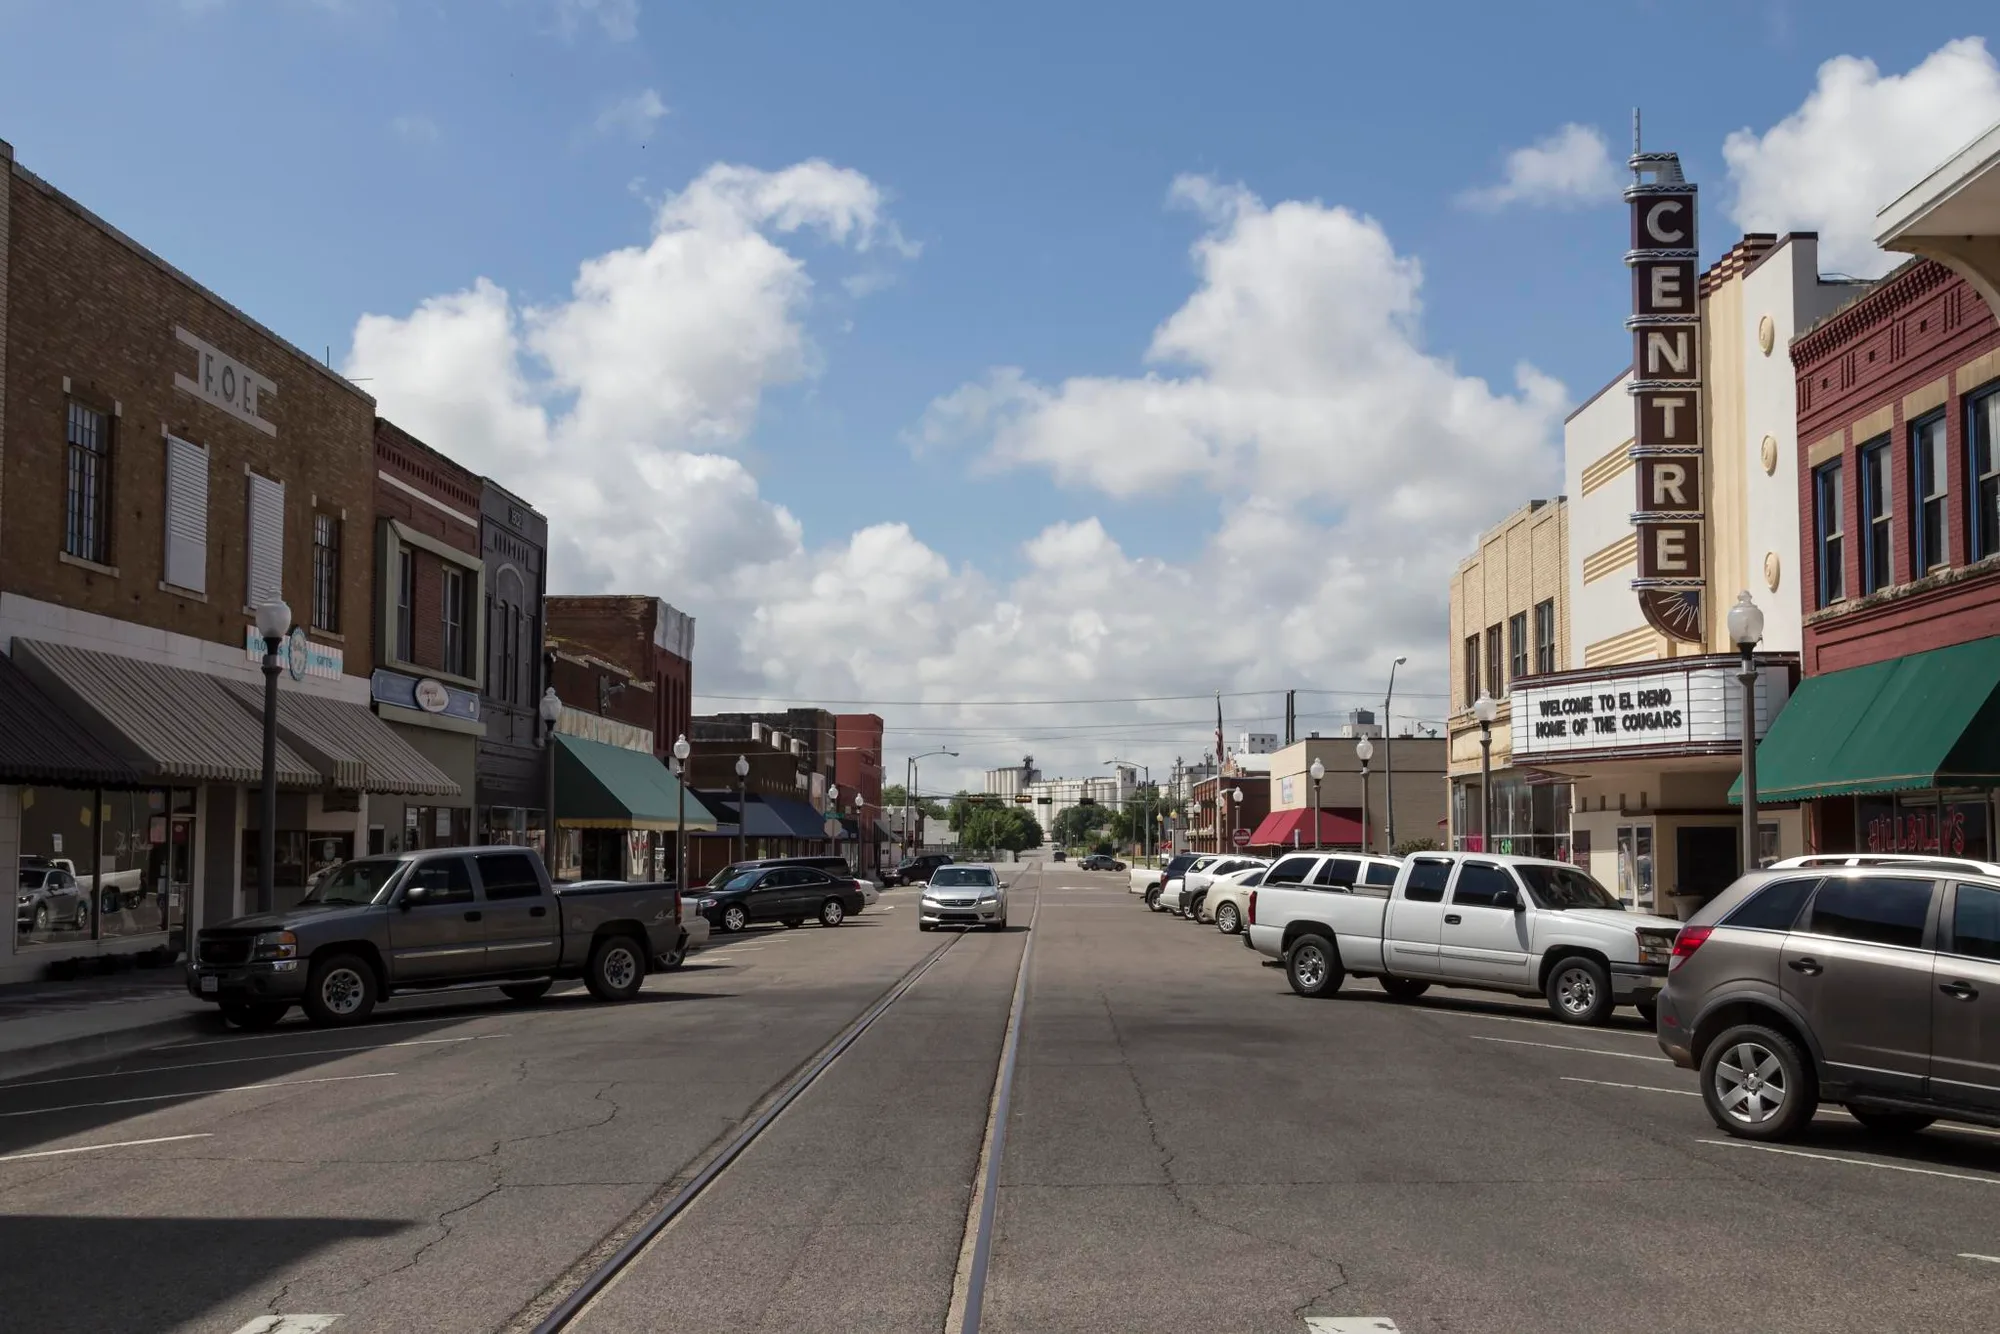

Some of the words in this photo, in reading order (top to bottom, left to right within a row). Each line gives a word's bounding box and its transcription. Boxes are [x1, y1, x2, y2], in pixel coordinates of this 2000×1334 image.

[205, 353, 255, 416] F.O.E.
[1646, 200, 1688, 571] CENTRE
[253, 639, 283, 655] FLOS
[316, 655, 333, 668] GIFTS
[1539, 695, 1594, 717] WELCOME
[1598, 694, 1616, 713] TO
[1618, 691, 1634, 710] EL
[1637, 688, 1672, 709] RENO
[1535, 720, 1567, 739] HOME
[1572, 717, 1588, 736] OF
[1592, 715, 1617, 734] THE
[1622, 709, 1682, 732] COUGARS
